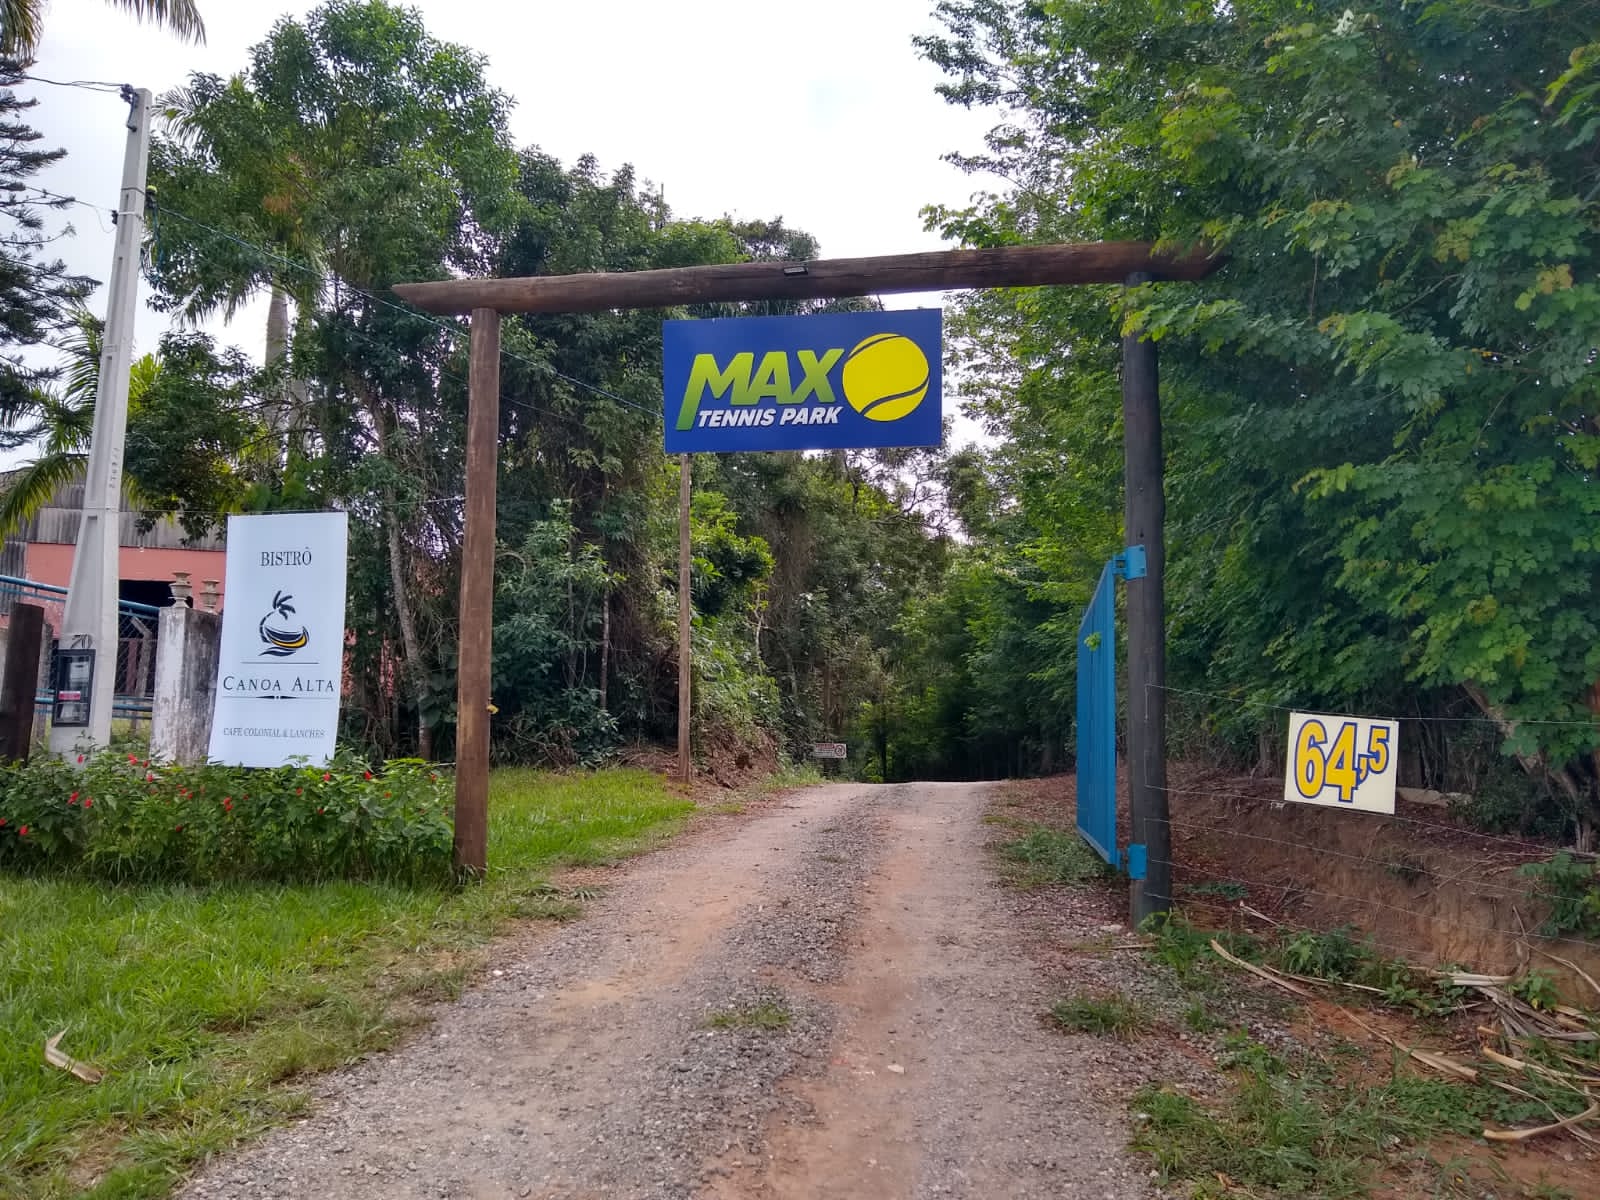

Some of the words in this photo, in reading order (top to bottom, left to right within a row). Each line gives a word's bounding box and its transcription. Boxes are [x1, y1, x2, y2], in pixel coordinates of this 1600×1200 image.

[676, 349, 845, 431] MAX
[699, 408, 776, 428] TENNIS
[779, 406, 843, 426] PARK
[260, 546, 312, 567] BISTRÔ
[223, 676, 281, 692] CANOA
[292, 676, 334, 692] ALTA
[243, 727, 280, 738] COLONIAL
[290, 729, 326, 739] LANCHES
[1294, 719, 1390, 803] 64,5
